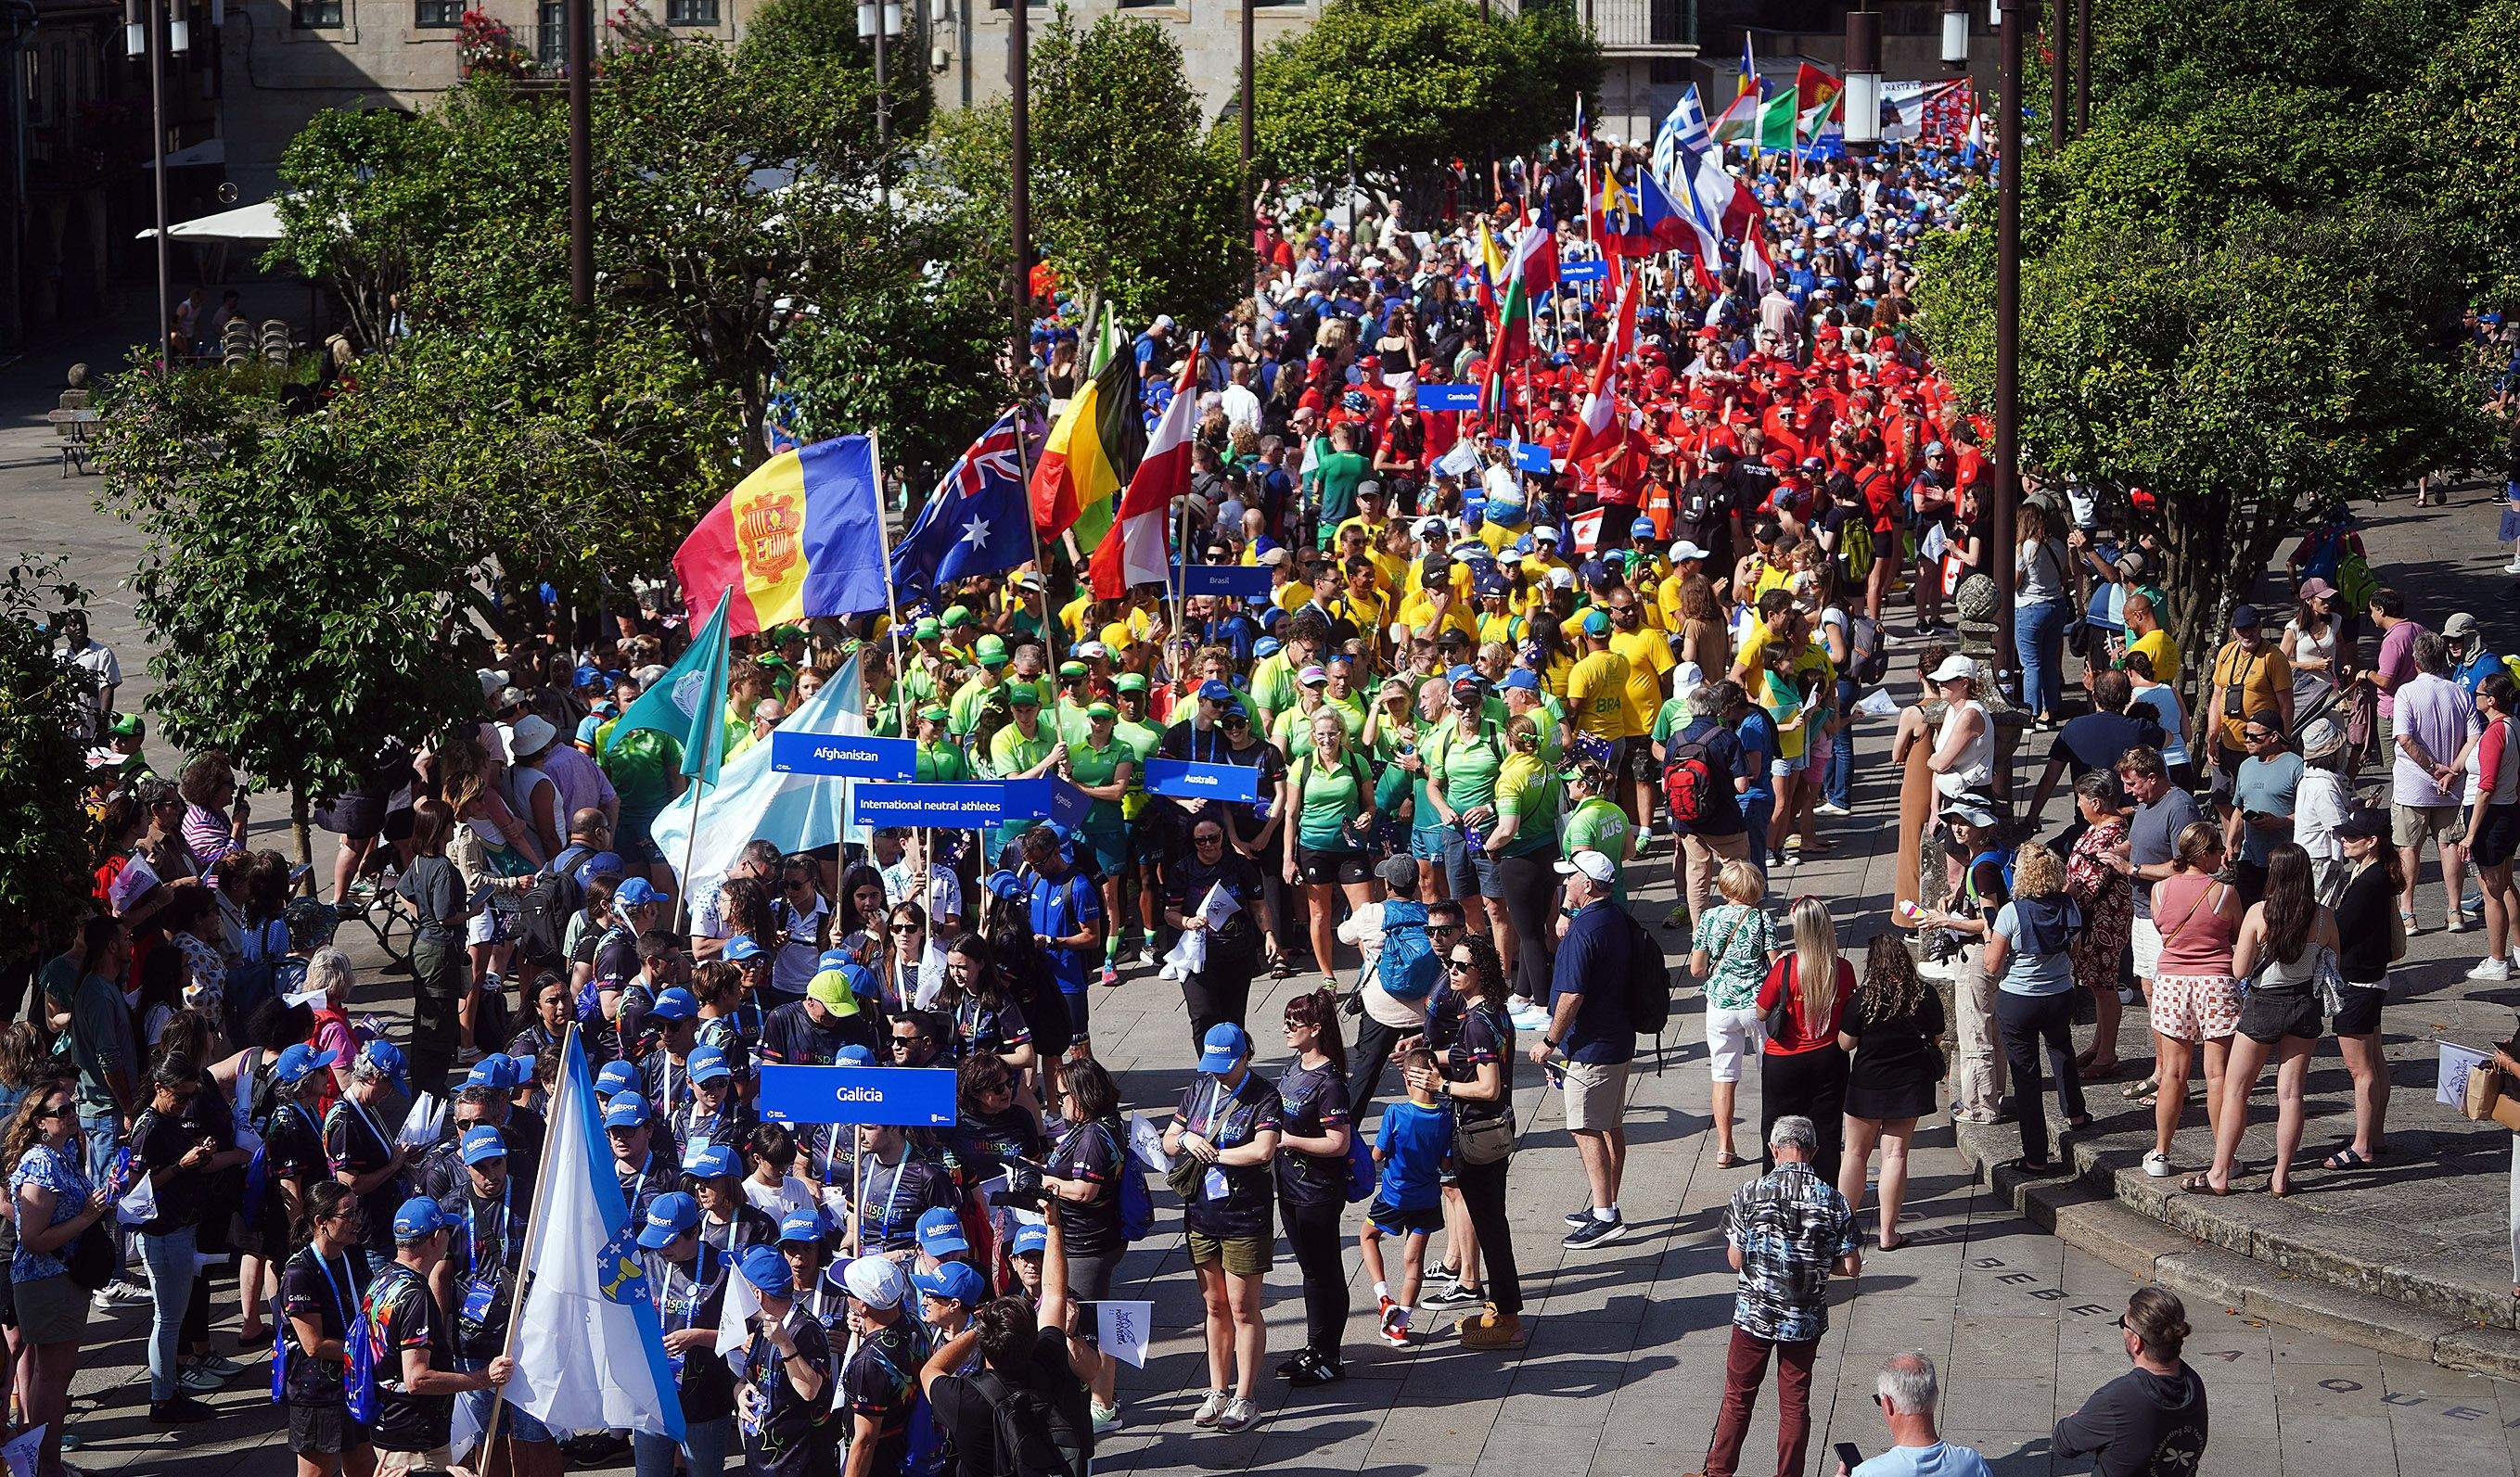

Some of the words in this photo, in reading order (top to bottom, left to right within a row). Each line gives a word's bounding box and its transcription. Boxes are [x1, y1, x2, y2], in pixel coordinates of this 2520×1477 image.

[1209, 576, 1230, 585] Brasil
[1595, 696, 1621, 713] BRA
[813, 746, 878, 762] Afghanistan
[1184, 773, 1218, 785] Australia
[860, 798, 923, 811] International
[925, 799, 959, 811] neutral
[961, 799, 1001, 813] athletes
[1600, 820, 1623, 841] AUS
[837, 1087, 883, 1102] Galicia
[926, 1224, 959, 1238] Multisport
